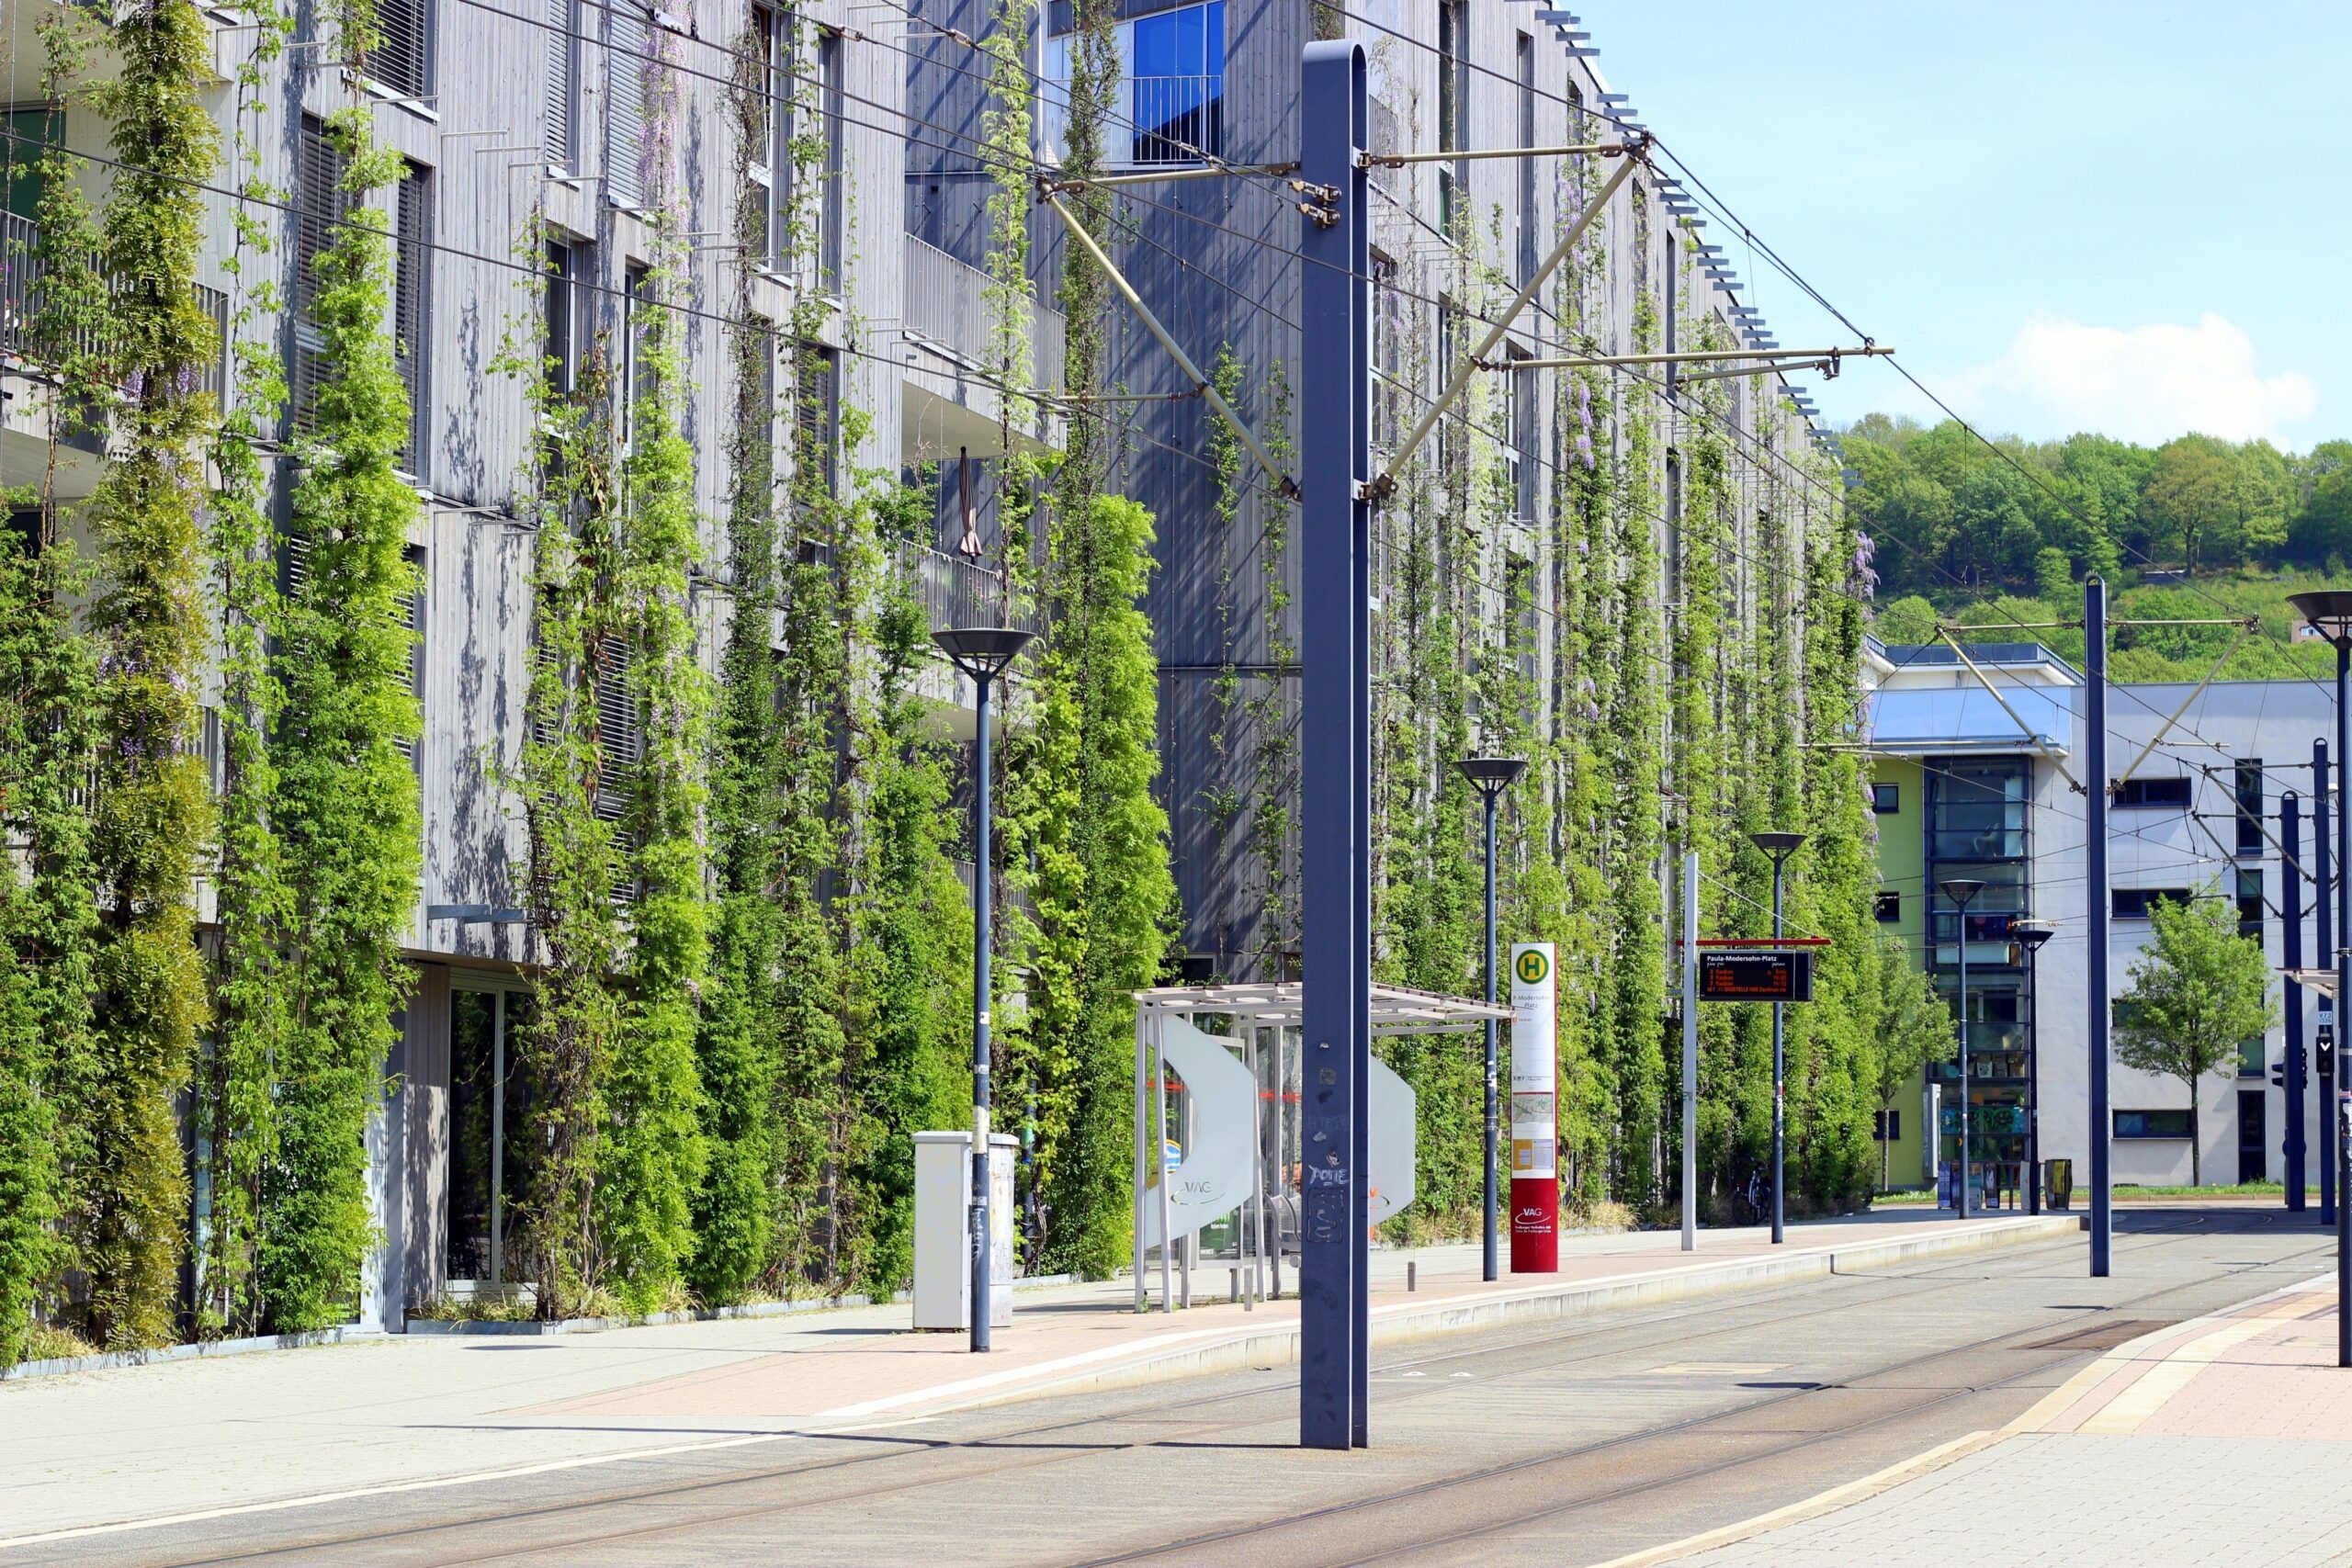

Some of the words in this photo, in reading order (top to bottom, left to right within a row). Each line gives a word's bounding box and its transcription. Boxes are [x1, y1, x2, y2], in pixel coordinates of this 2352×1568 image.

[1524, 958, 1540, 976] H
[1184, 1181, 1213, 1193] VAG
[1522, 1208, 1543, 1216] VAG
